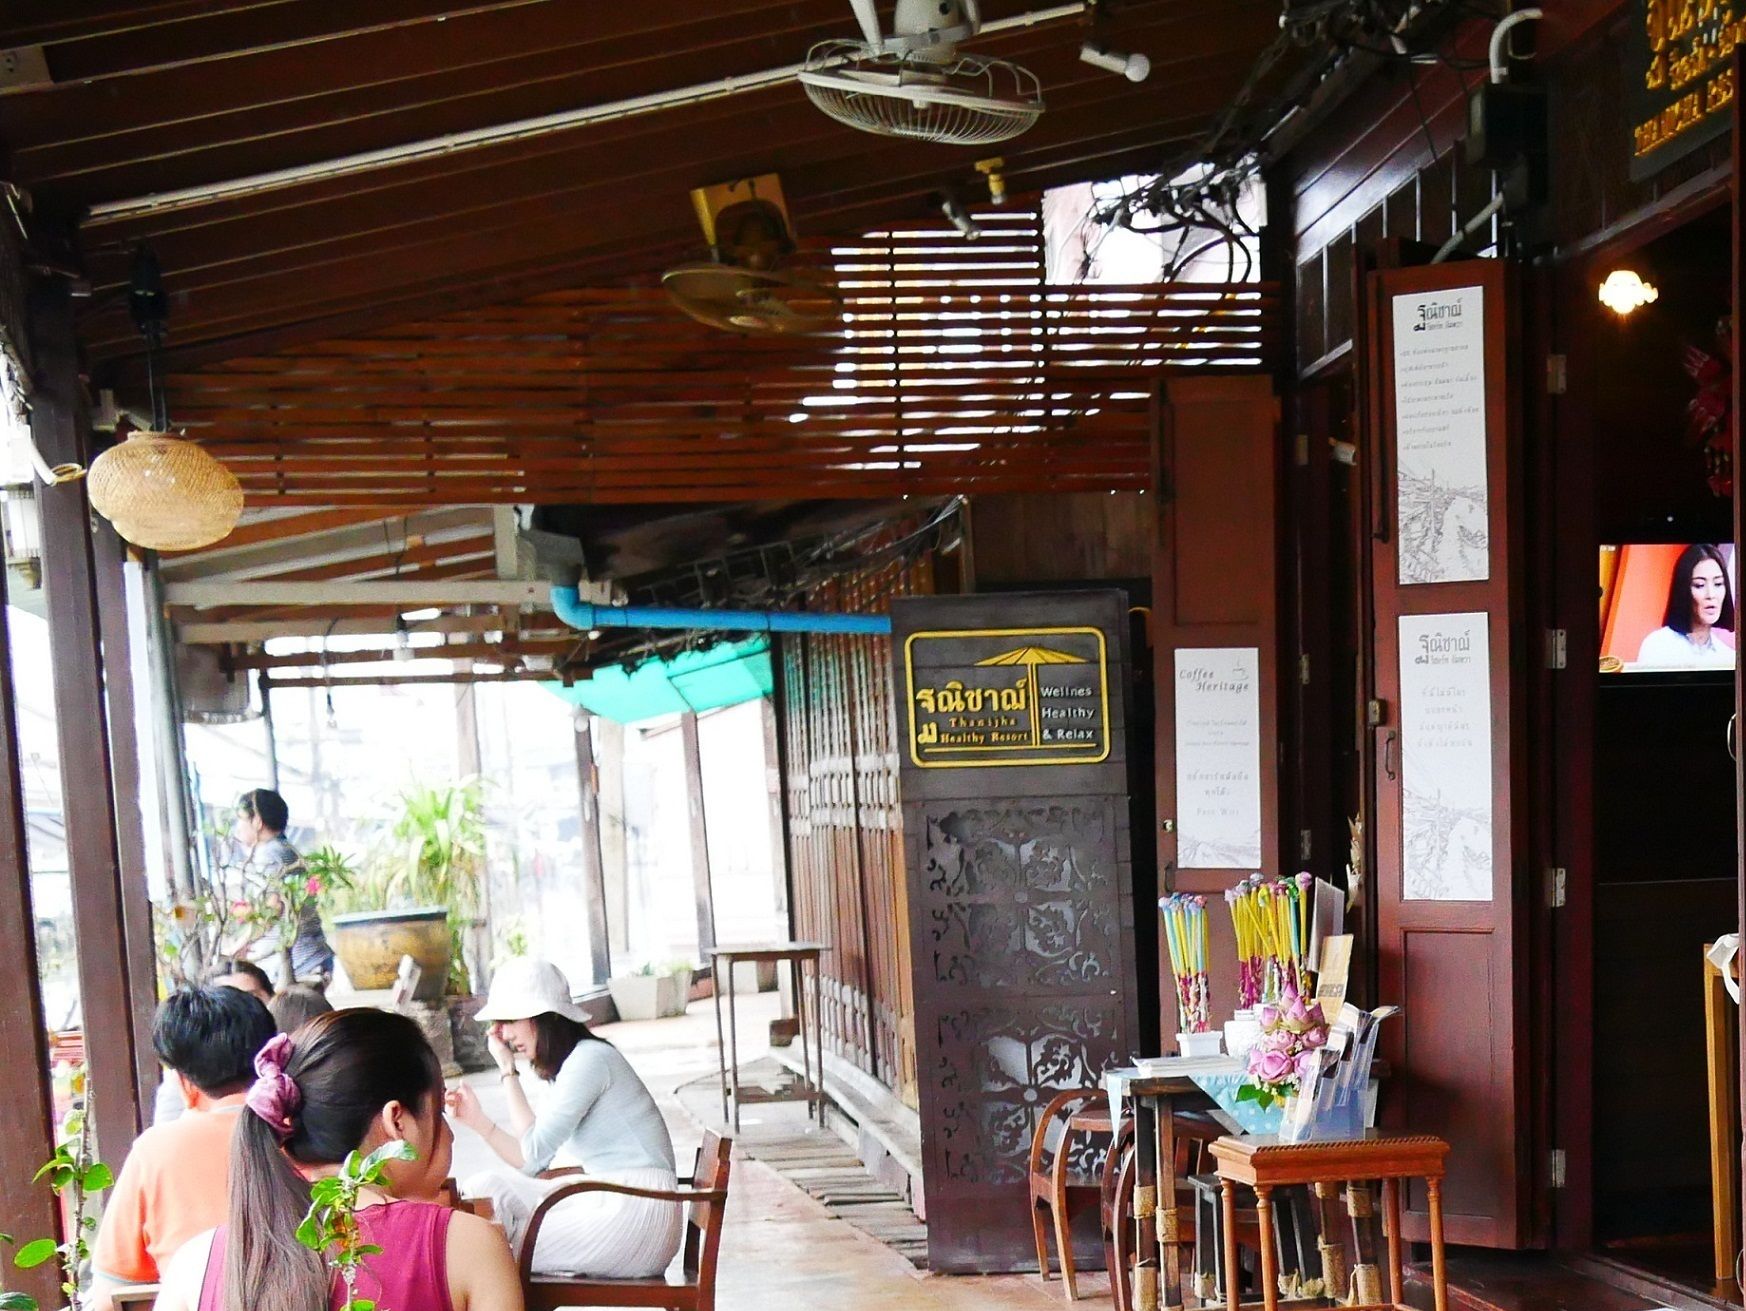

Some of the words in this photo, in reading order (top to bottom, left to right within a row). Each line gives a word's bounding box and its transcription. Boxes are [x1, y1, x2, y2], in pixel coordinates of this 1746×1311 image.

[1179, 668, 1214, 682] Coffee
[1040, 686, 1092, 697] Wellnes
[1195, 681, 1249, 694] Heritage
[1042, 706, 1095, 720] Healthy
[940, 731, 985, 744] Healthy
[991, 730, 1028, 743] Resort
[1042, 728, 1052, 740] &
[1056, 728, 1093, 740] Relax
